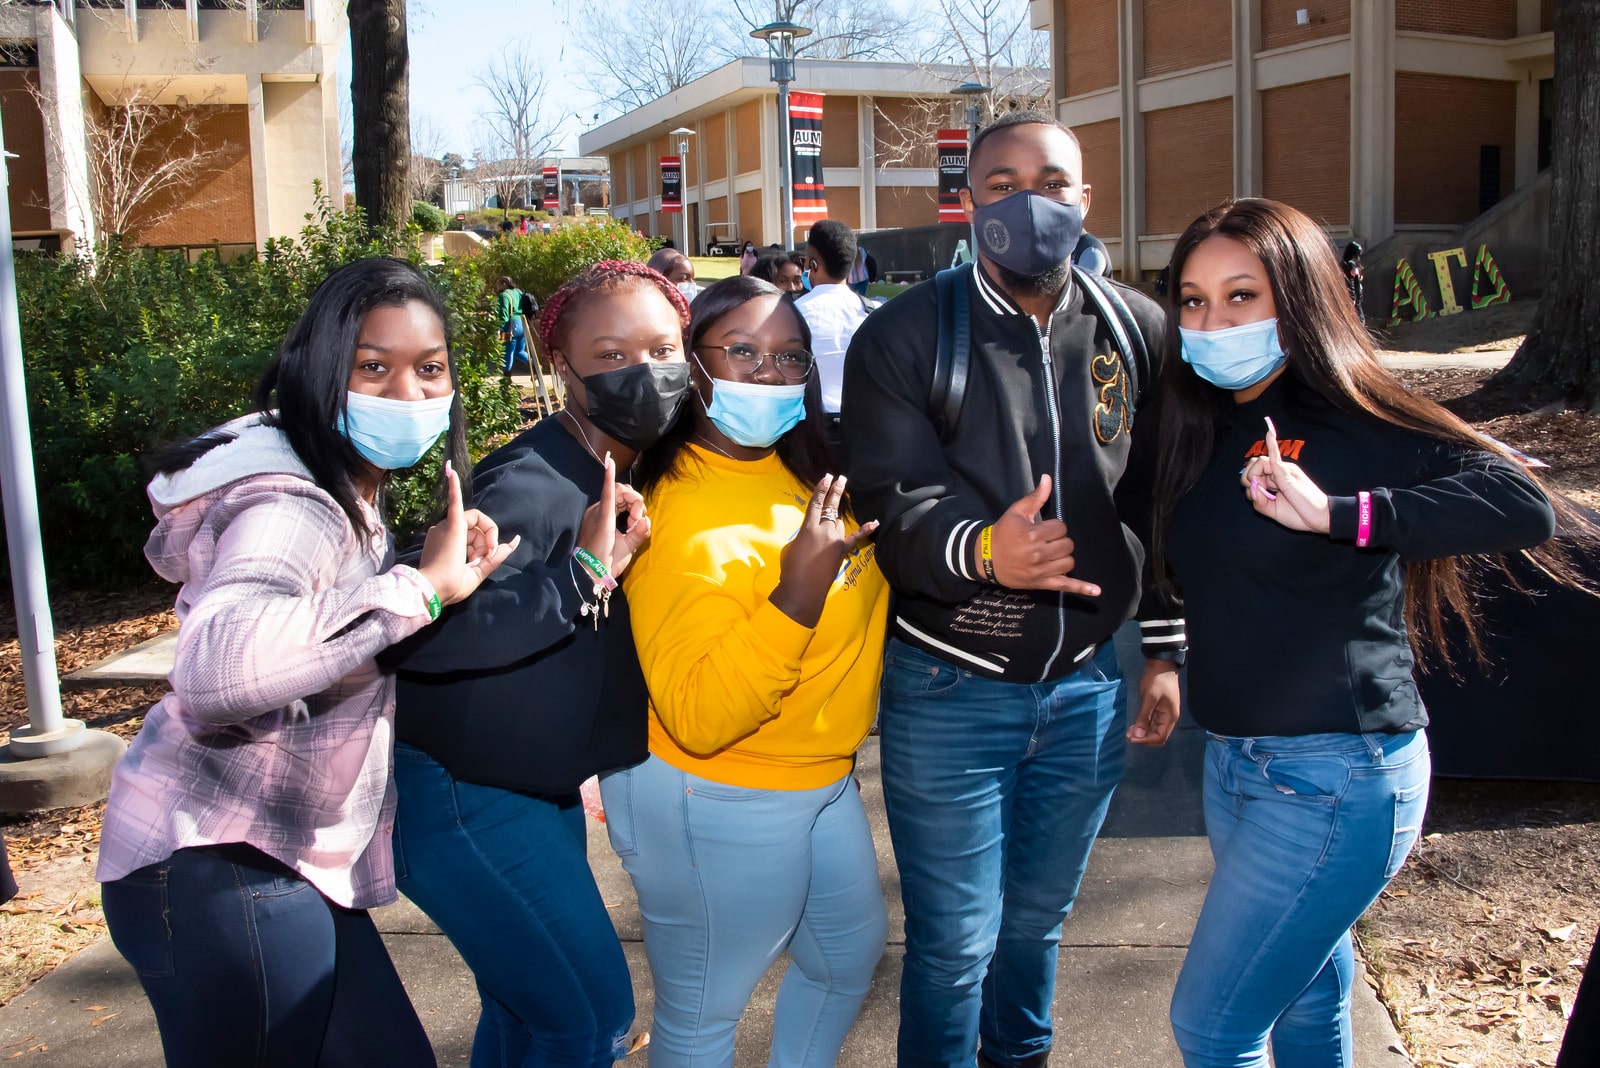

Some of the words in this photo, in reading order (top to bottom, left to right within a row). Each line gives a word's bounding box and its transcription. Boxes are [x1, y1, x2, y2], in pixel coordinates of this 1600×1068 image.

[793, 129, 822, 147] AUM
[940, 155, 967, 167] AUM
[1244, 439, 1305, 461] AM
[1361, 503, 1369, 526] HOPE
[843, 563, 862, 591] Sigma
